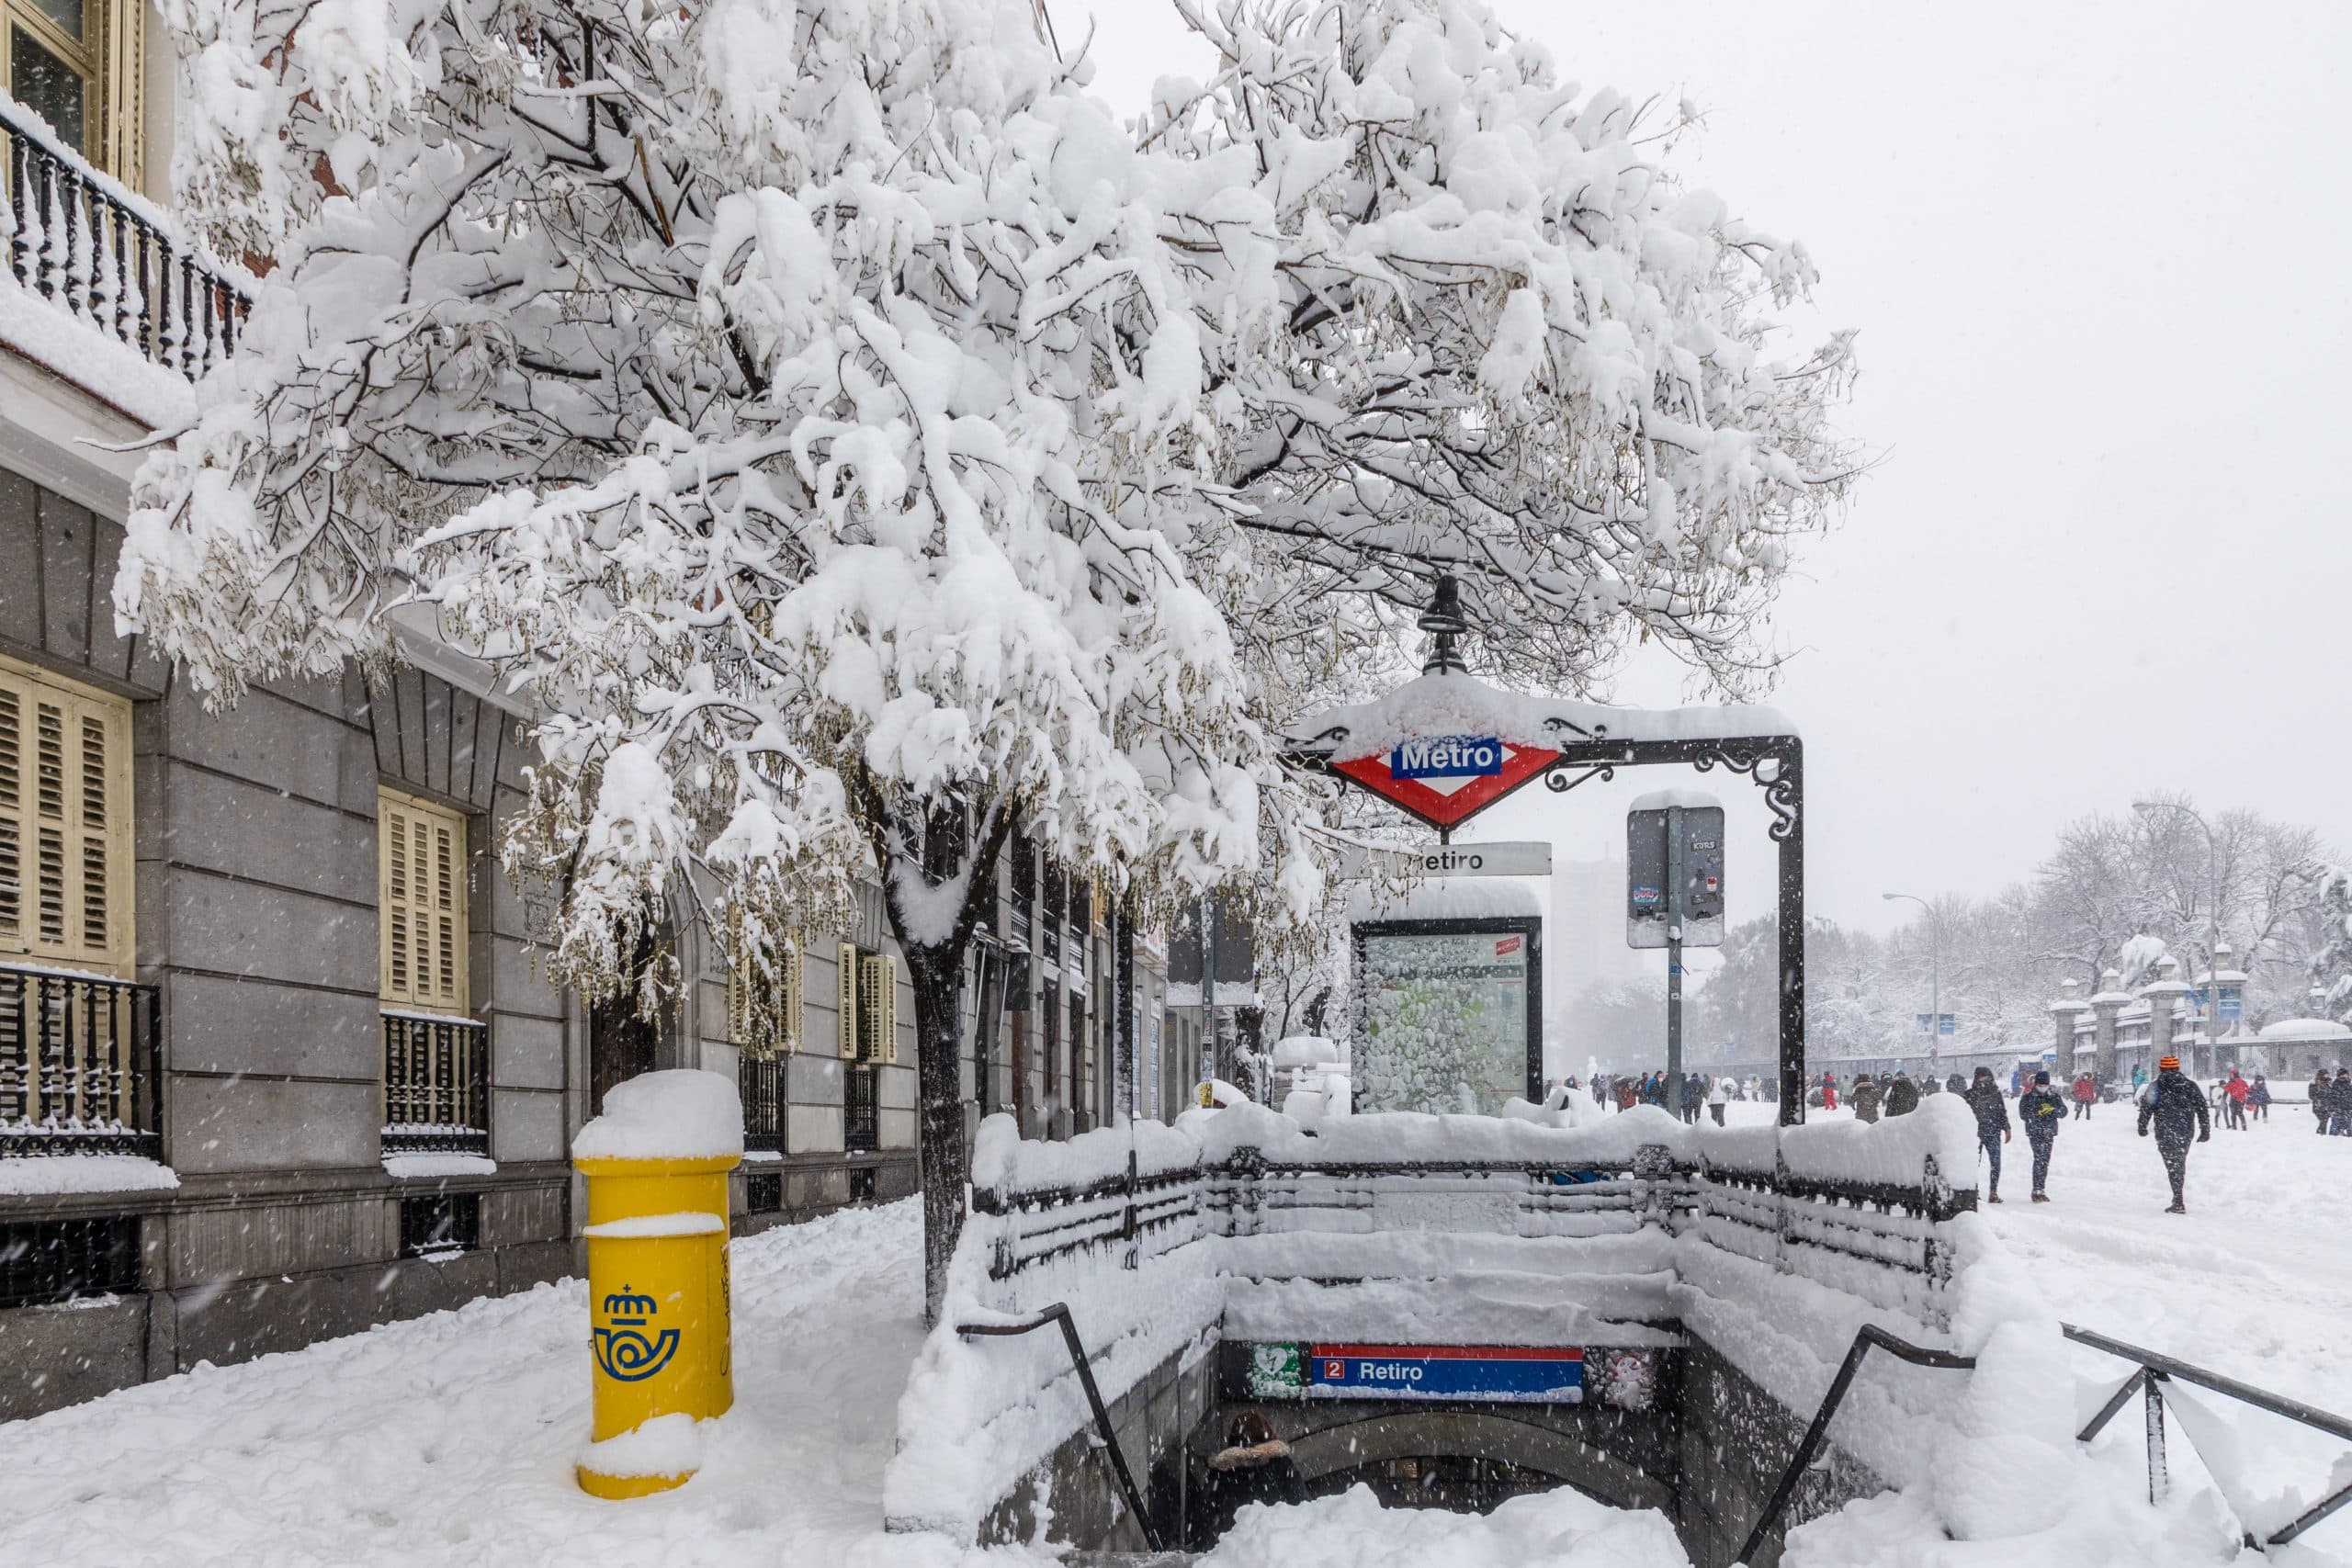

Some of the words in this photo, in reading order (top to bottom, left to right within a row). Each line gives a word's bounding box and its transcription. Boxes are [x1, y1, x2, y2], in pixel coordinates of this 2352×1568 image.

[1401, 741, 1494, 770] Metro
[1416, 851, 1483, 870] etiro
[1329, 1362, 1340, 1377] 2
[1360, 1362, 1423, 1381] Retiro
